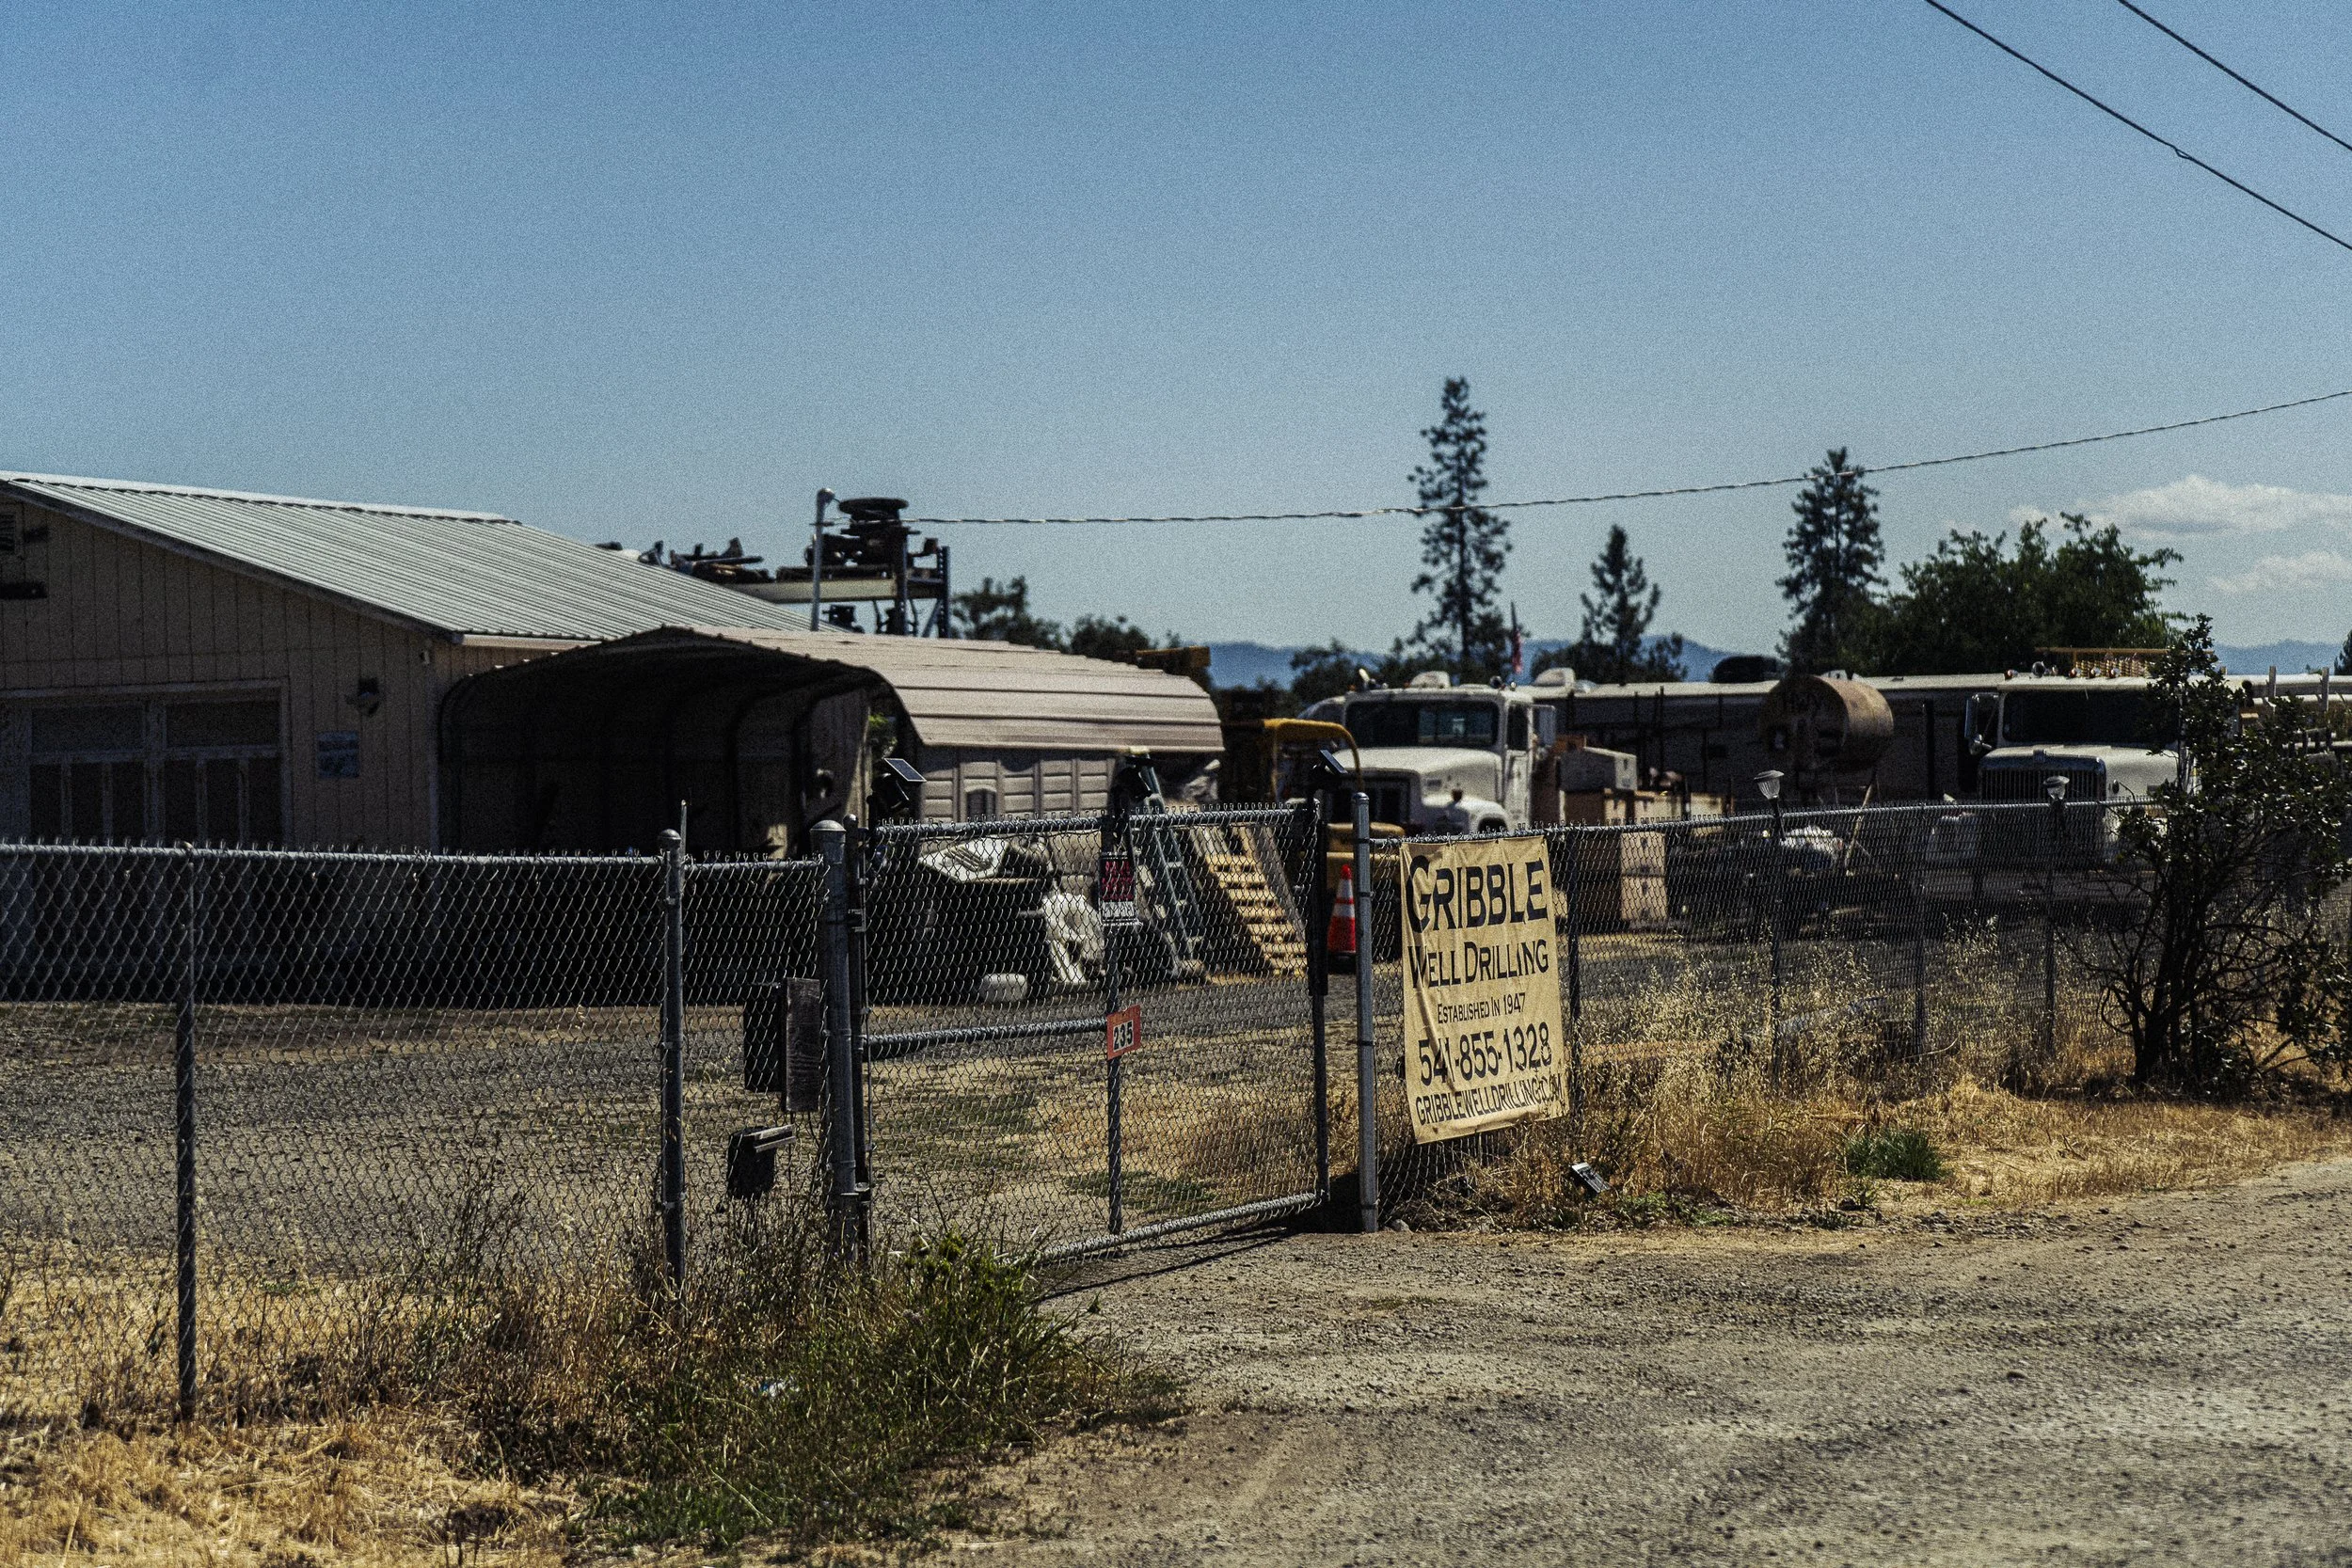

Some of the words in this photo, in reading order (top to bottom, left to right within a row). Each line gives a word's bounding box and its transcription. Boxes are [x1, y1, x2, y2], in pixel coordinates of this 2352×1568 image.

[1406, 855, 1549, 933] GRIBBLE
[1407, 945, 1461, 988] WELL
[1464, 939, 1549, 984] DRILLING
[1438, 1001, 1490, 1023] ESTABLISHED
[1491, 997, 1501, 1017] IN
[1503, 992, 1526, 1015] 1947
[1114, 1022, 1133, 1050] 235
[1418, 1022, 1552, 1085] 541-855-1328
